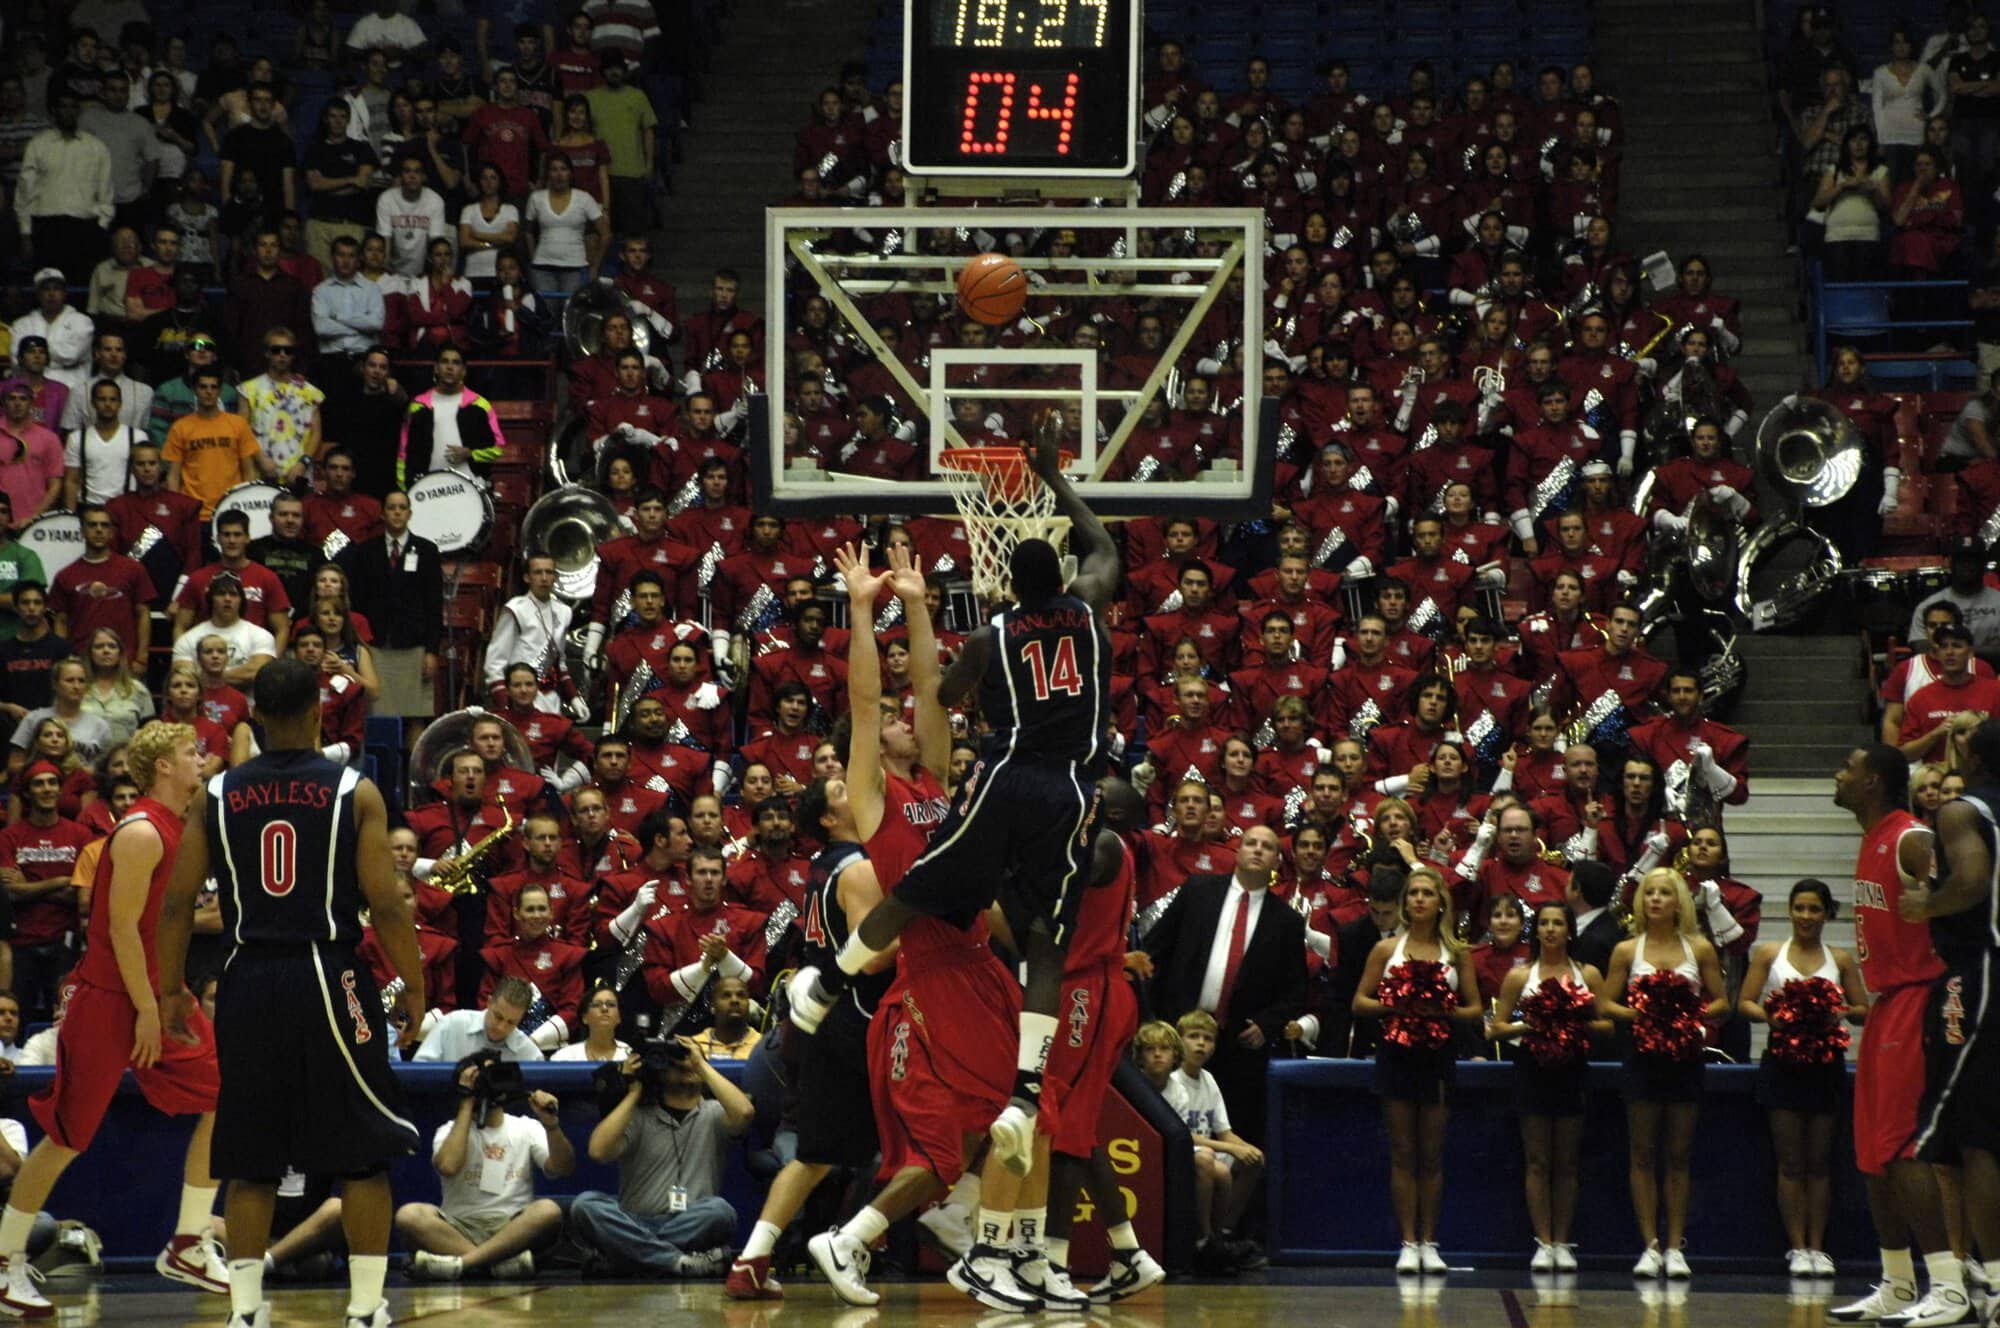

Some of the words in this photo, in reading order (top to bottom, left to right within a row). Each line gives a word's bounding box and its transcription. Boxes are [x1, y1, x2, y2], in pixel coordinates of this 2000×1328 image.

[954, 0, 1108, 47] 19:27
[960, 71, 1079, 155] 04
[243, 499, 271, 511] YAMA
[426, 483, 465, 499] YAMAHA
[1021, 635, 1084, 701] 14
[227, 779, 333, 813] BAYLESS
[260, 820, 297, 897] 0
[802, 890, 827, 949] 4
[340, 968, 373, 1046] CATS
[1068, 987, 1089, 1048] CATS
[1942, 975, 1967, 1046] CATS
